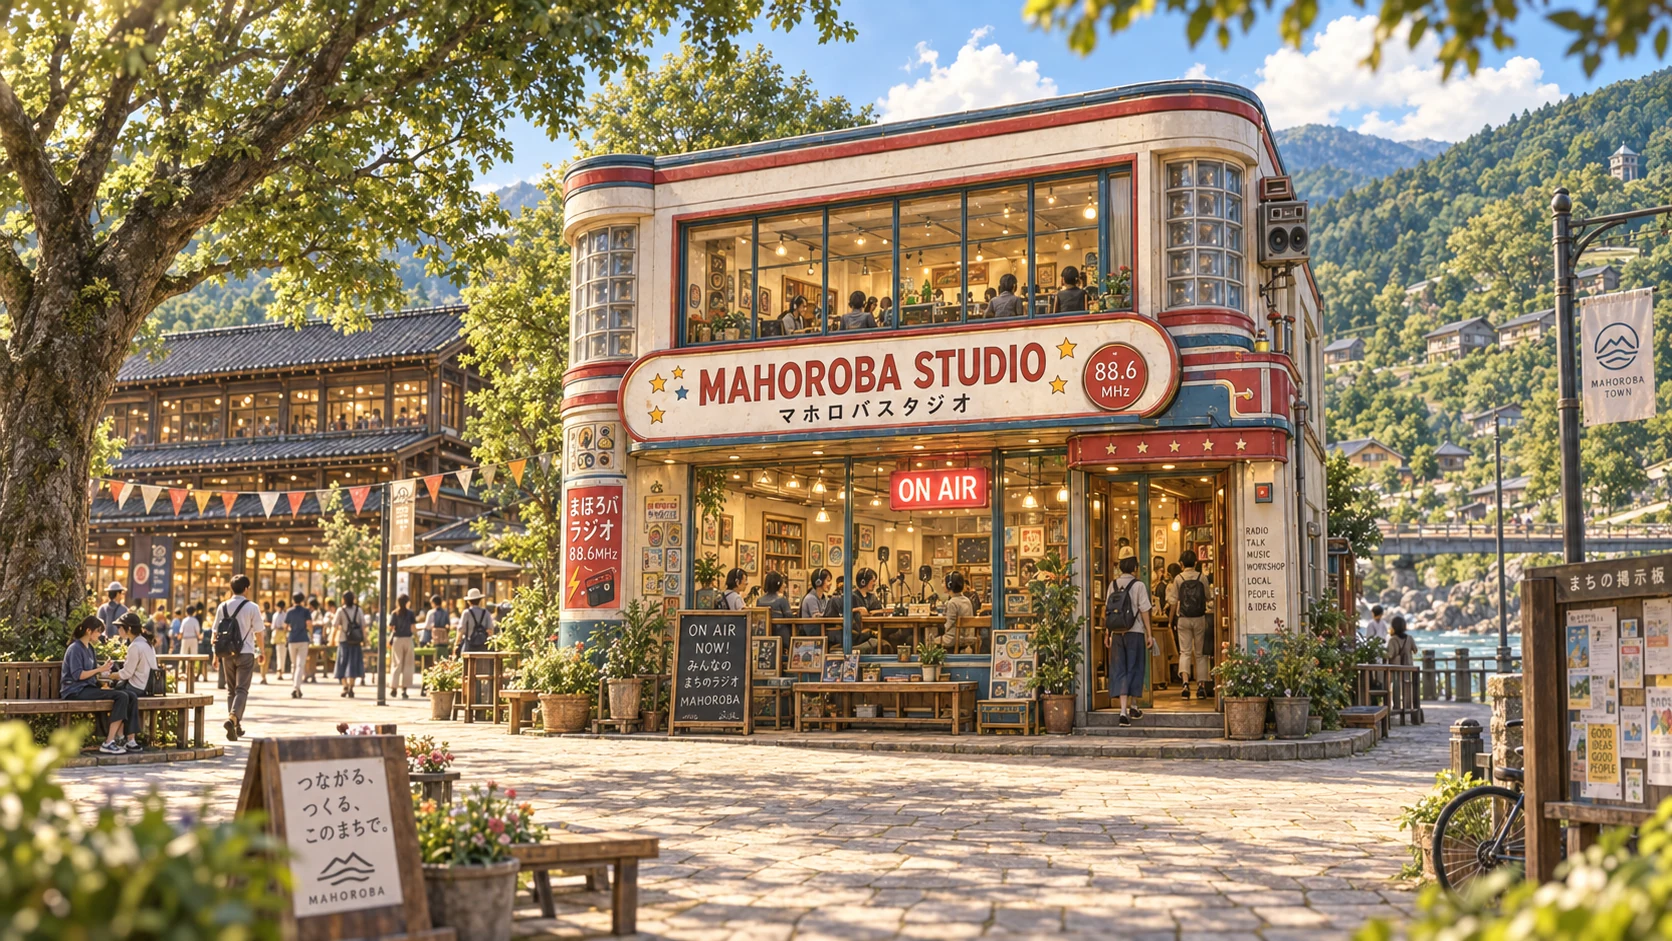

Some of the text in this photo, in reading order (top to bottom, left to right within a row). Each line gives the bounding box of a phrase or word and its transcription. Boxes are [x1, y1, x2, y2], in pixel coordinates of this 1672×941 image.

[699, 342, 1047, 406] MAHOROBA STUDIO
[1095, 360, 1137, 381] 88.6
[1591, 376, 1645, 388] MAHOROBA
[1101, 385, 1130, 398] MHz
[1604, 388, 1632, 398] TOWN
[779, 393, 971, 423] マホロバスタジオ
[898, 475, 977, 502] ON AIR
[570, 495, 619, 517] まほろバ
[570, 519, 614, 542] ラジオ
[1246, 526, 1268, 535] RADIO
[569, 546, 618, 561] 88.6MHz
[1247, 550, 1270, 558] MUSIC
[1247, 562, 1285, 571] WORKSHOP
[1247, 577, 1271, 585] LOCAL
[1570, 566, 1665, 592] まちの掲示板
[1248, 590, 1275, 598] PEOPLE
[1248, 602, 1277, 611] & IDEAS
[688, 624, 736, 637] ON AIR
[695, 642, 730, 654] NOW!
[687, 660, 732, 671] みんなの
[684, 676, 739, 688] まちのラジオ
[680, 694, 740, 707] MAHOROBA
[1591, 728, 1613, 738] GOOD
[1592, 740, 1613, 750] IDEAS
[1591, 752, 1613, 762] GOOD
[1590, 764, 1617, 774] PEOPLE
[298, 768, 374, 791] つながる、
[303, 796, 360, 817] つくる、
[306, 817, 388, 844] このまちで。
[309, 886, 386, 905] MAHOROBA
